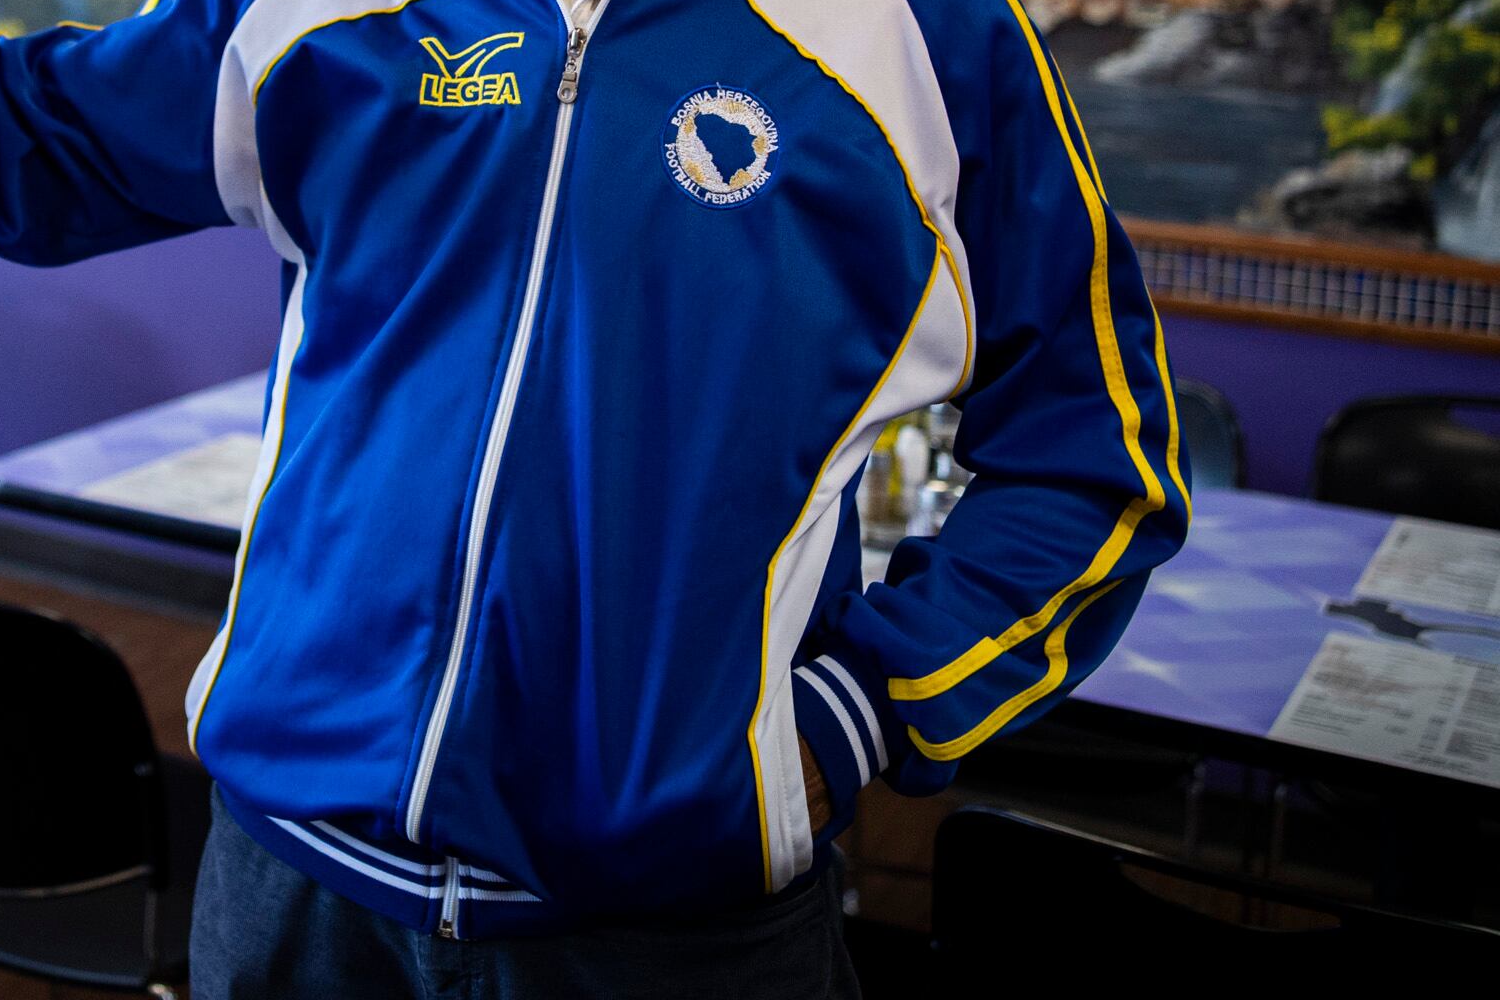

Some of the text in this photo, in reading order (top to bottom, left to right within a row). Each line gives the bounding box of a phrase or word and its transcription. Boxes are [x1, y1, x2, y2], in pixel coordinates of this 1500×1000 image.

[420, 72, 521, 106] LEGEA
[671, 89, 779, 153] BOSNIA HERZEGOVINA
[664, 143, 771, 205] FOOTBALL FEDERATION
